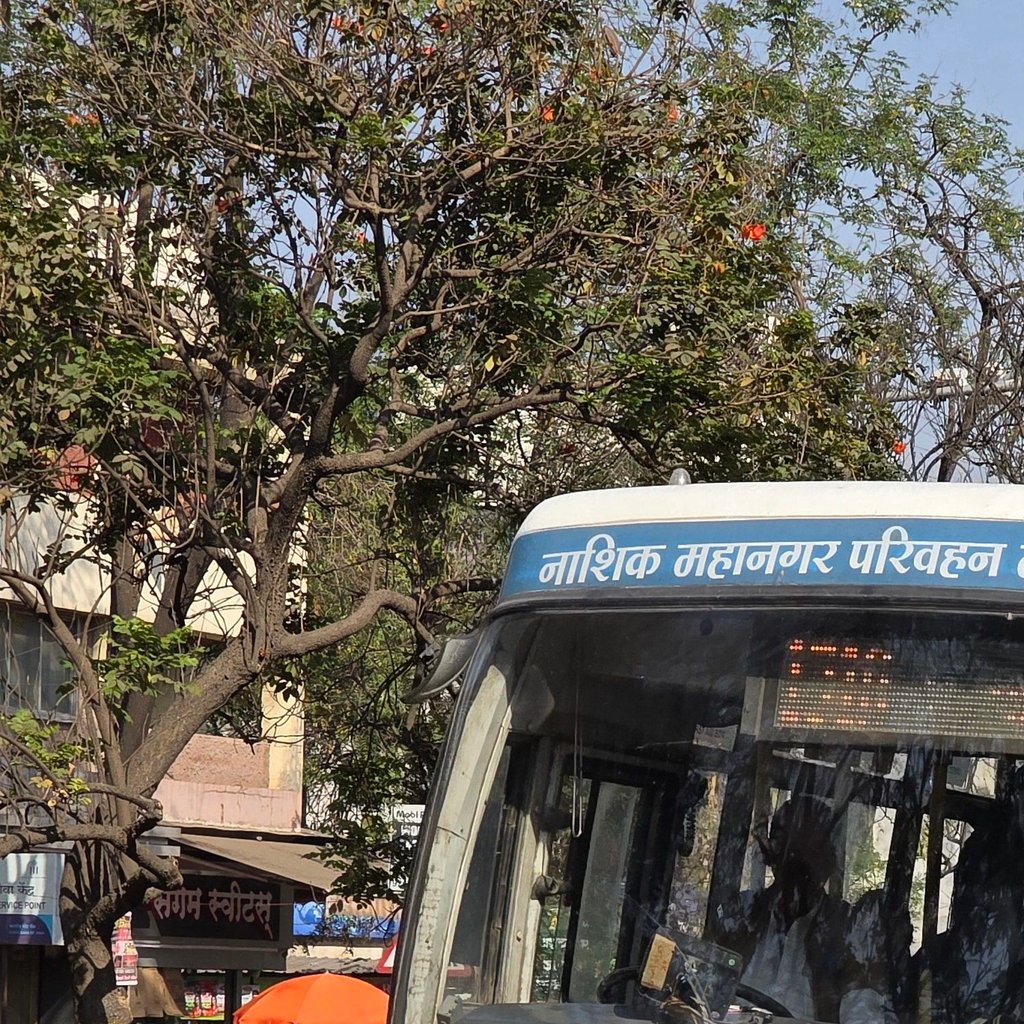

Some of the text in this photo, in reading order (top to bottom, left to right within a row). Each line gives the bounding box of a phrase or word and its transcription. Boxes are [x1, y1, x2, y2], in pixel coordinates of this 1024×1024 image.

[538, 533, 667, 586] नाशिक
[673, 540, 842, 580] महानगर
[849, 525, 1008, 580] परिवहन
[25, 901, 46, 910] POINT
